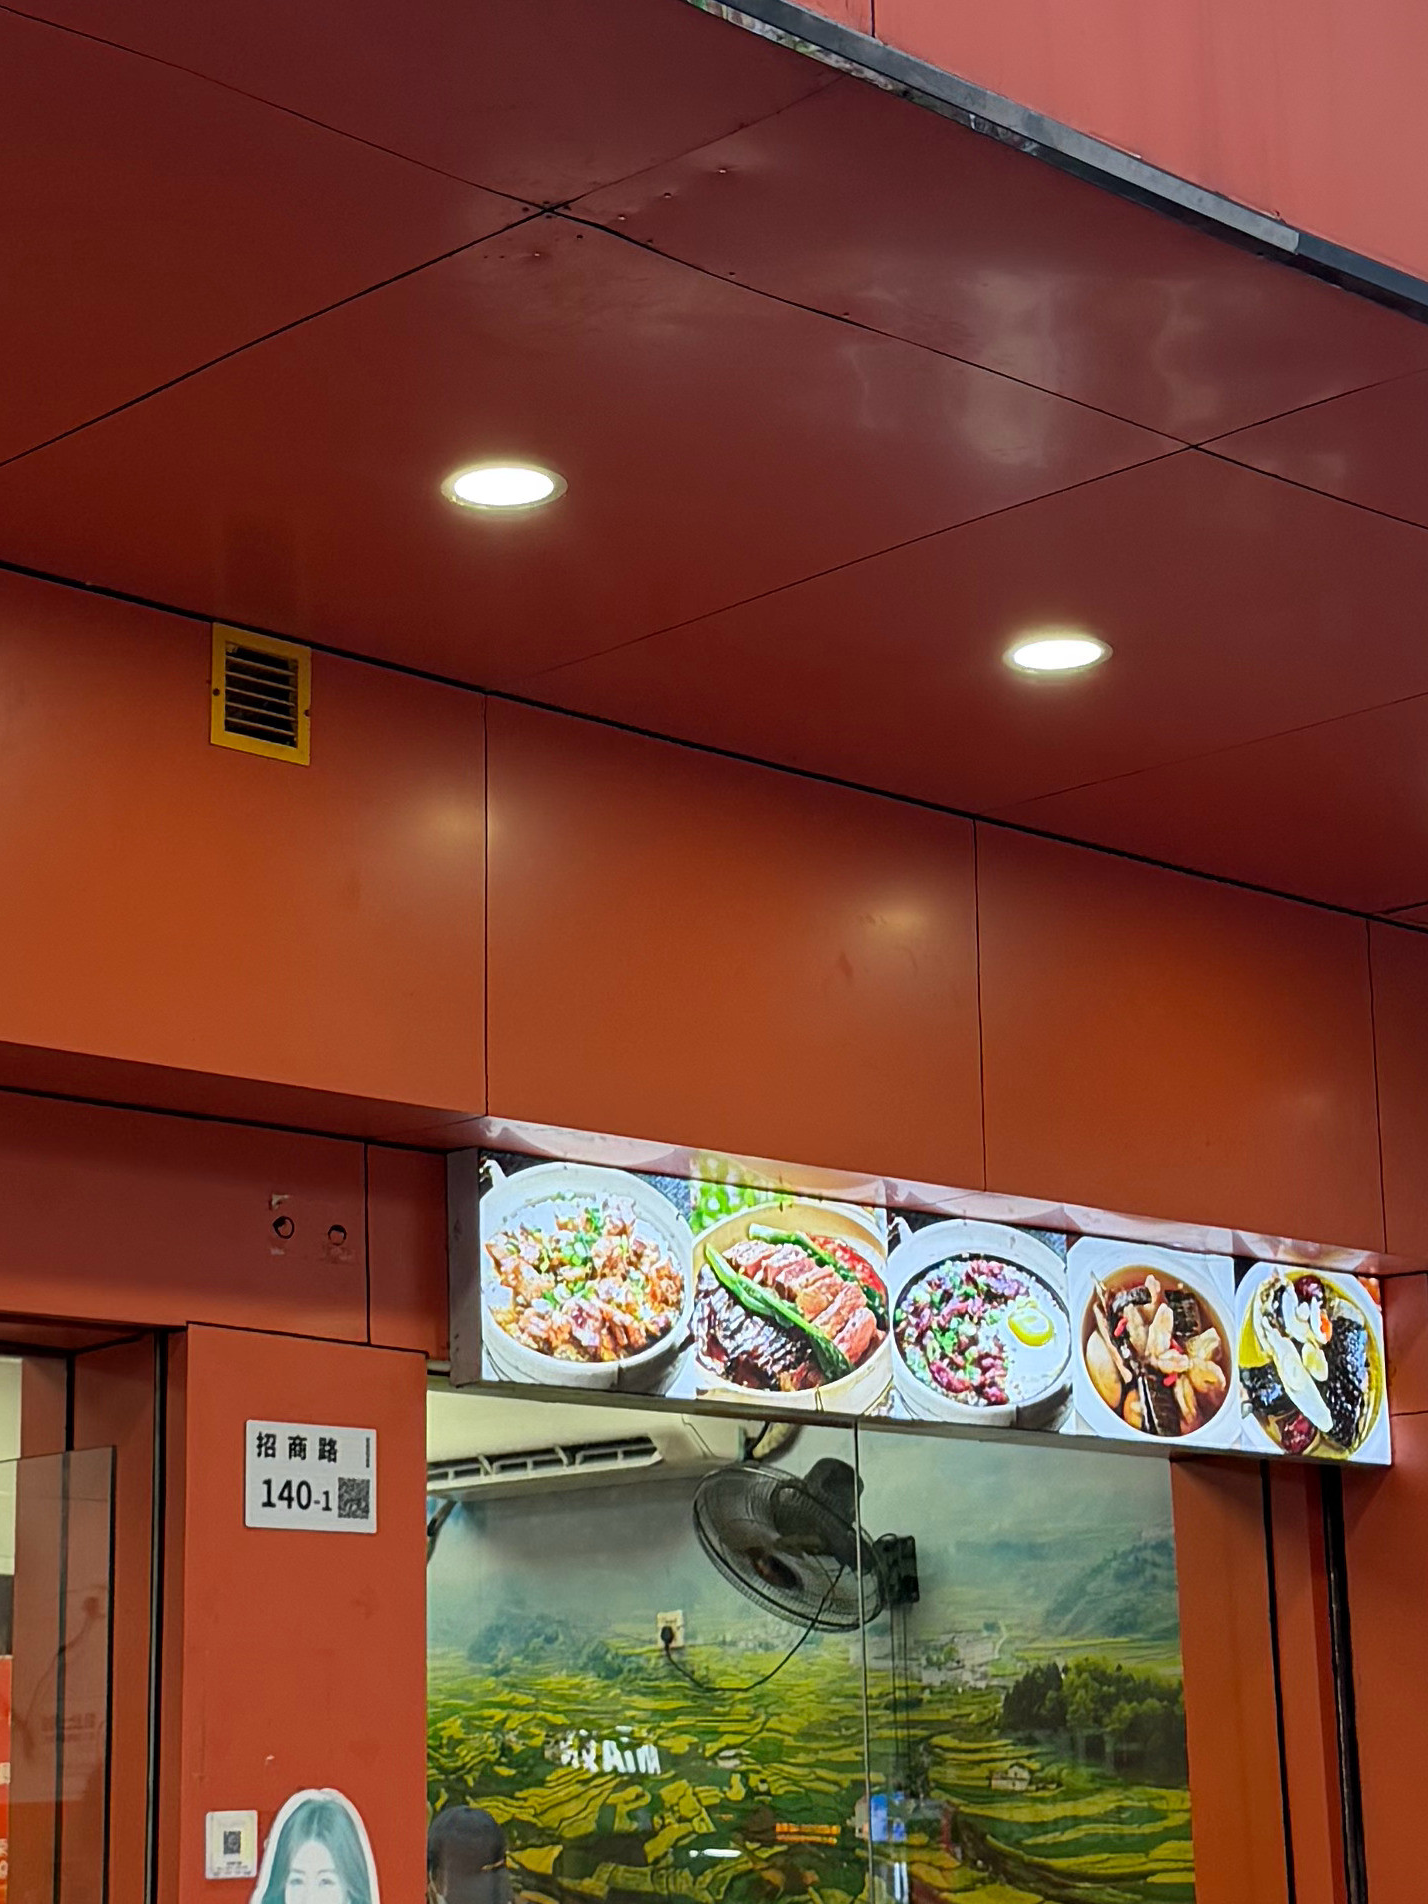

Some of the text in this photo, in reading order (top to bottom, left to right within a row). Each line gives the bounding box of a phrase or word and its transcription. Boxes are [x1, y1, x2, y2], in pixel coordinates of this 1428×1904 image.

[256, 1431, 338, 1464] 招商路
[261, 1478, 333, 1512] 140-1
